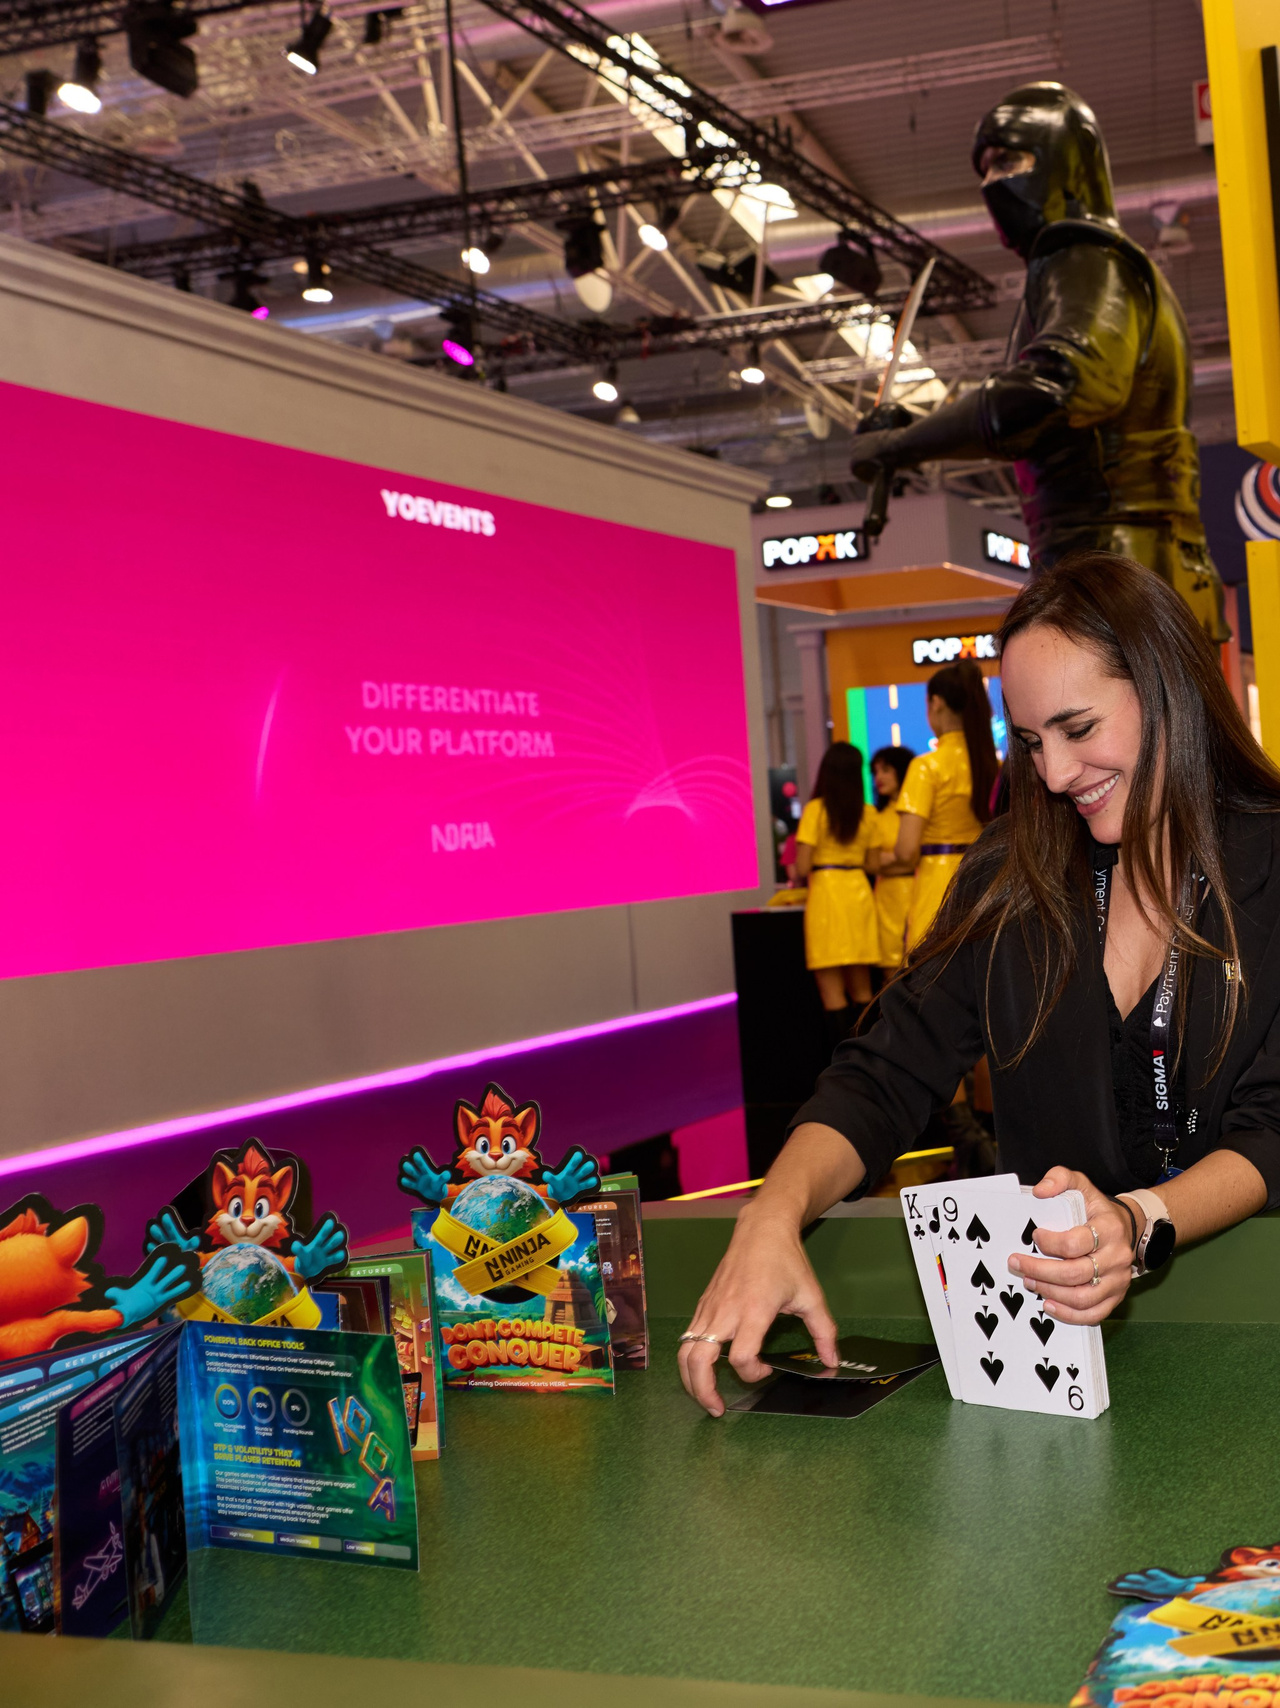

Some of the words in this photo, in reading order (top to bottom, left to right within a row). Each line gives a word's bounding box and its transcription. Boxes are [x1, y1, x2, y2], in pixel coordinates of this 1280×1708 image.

[362, 681, 539, 717] DIFFERENTIATE
[345, 726, 422, 755] YOUR
[430, 728, 555, 758] PLATFORM
[1156, 950, 1179, 1013] Payment
[903, 1193, 922, 1220] K
[942, 1196, 958, 1222] 9
[498, 1233, 552, 1269] NINJA
[505, 1256, 535, 1276] GAMING
[204, 1335, 238, 1346] POWERFUL
[238, 1338, 257, 1347] BACK
[257, 1339, 281, 1349] OFFICE
[281, 1341, 306, 1351] TOOLS
[498, 1318, 586, 1347] COMPETE
[448, 1338, 581, 1373] CONQUER
[494, 1380, 530, 1388] Domination
[530, 1380, 549, 1388] Starts
[214, 1452, 234, 1461] DRIVE
[235, 1454, 261, 1464] PLAYER
[262, 1457, 302, 1468] RETENTION
[234, 1445, 273, 1456] VOLATILITY
[273, 1448, 293, 1458] THAT
